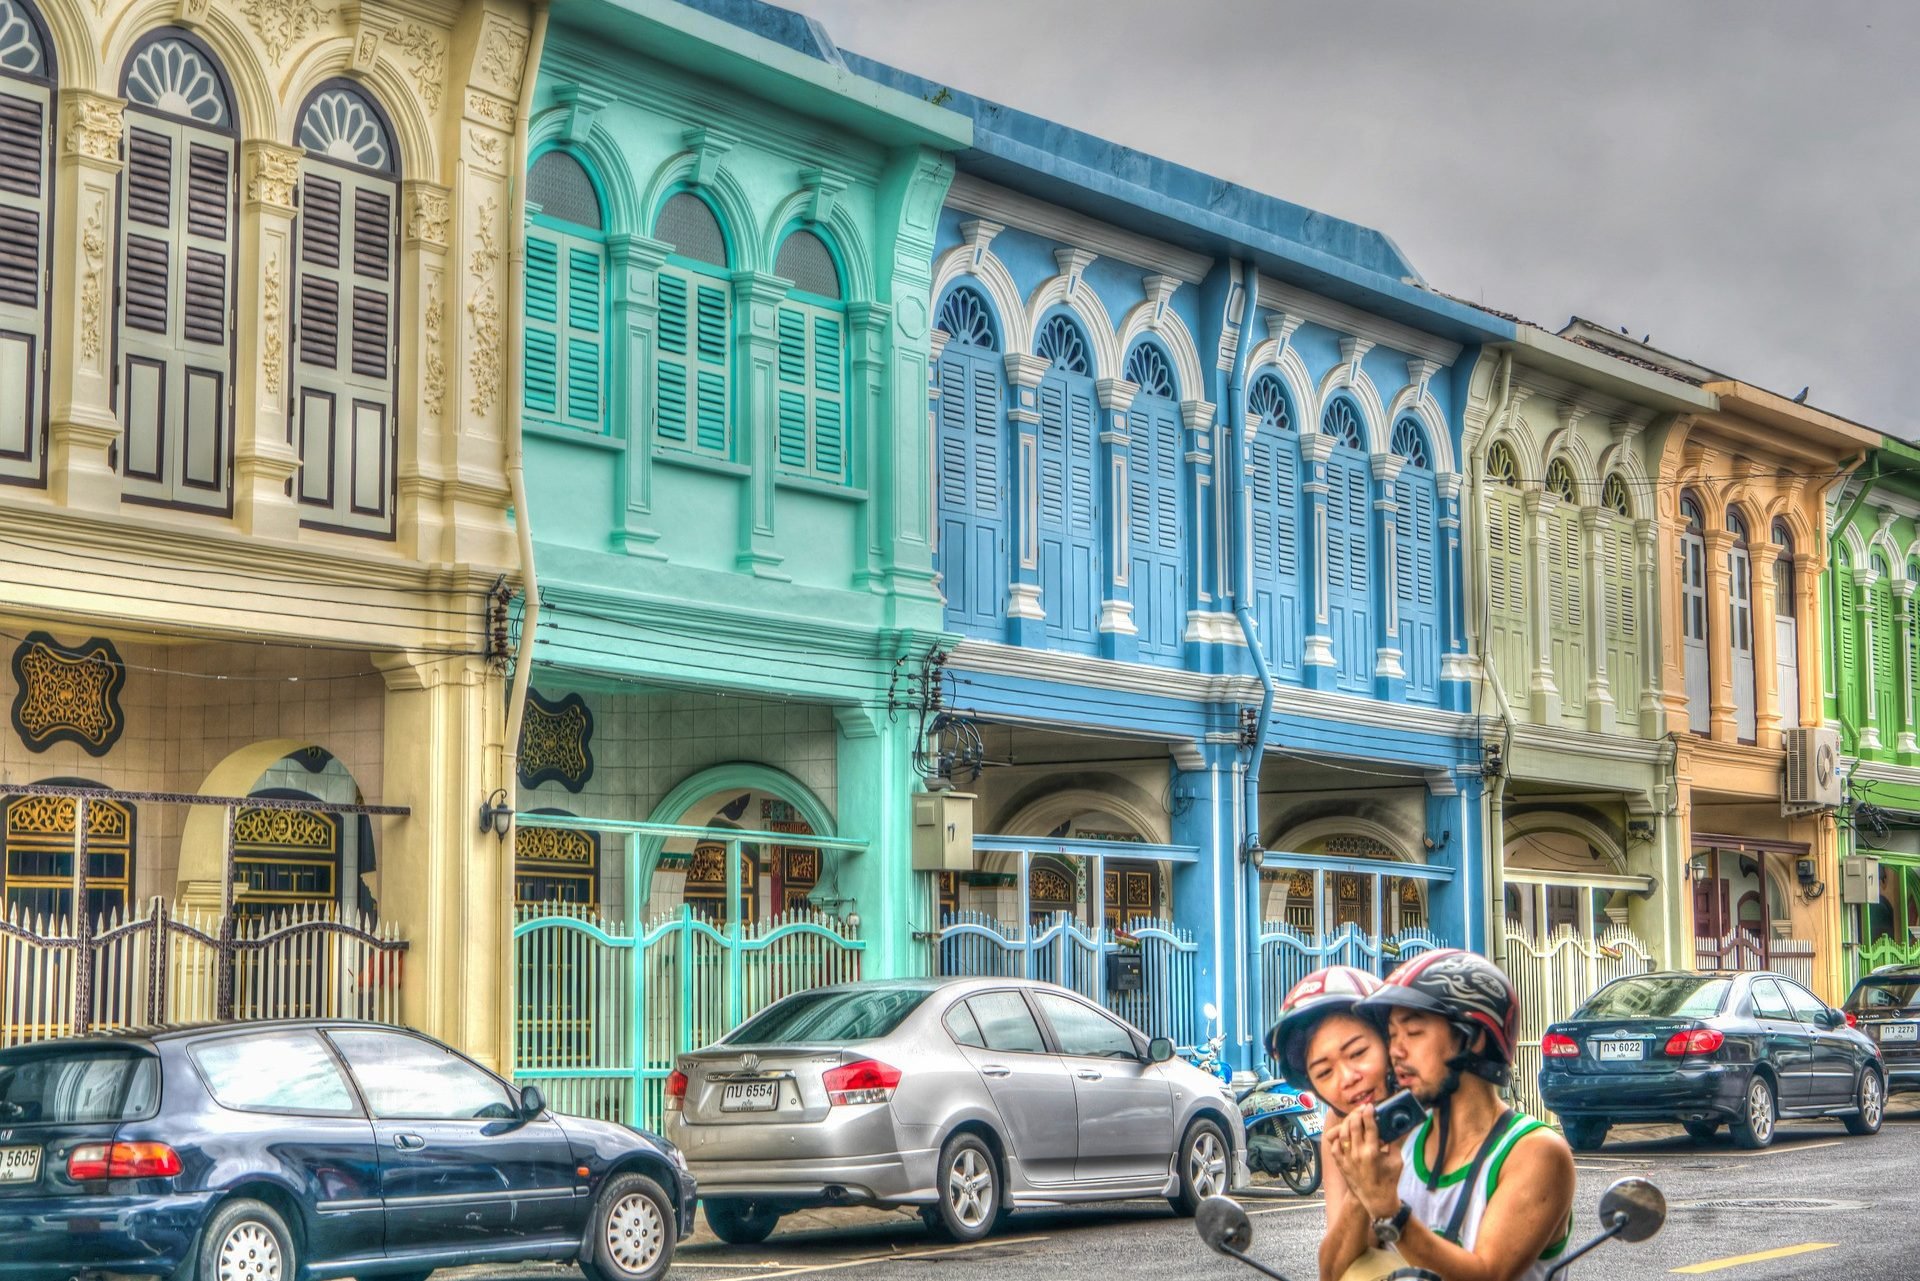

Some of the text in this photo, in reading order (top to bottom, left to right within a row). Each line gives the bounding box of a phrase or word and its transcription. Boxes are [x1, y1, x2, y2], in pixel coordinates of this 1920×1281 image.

[1619, 1042, 1640, 1052] 6022
[746, 1084, 773, 1097] 6554
[7, 1150, 36, 1167] 5605
